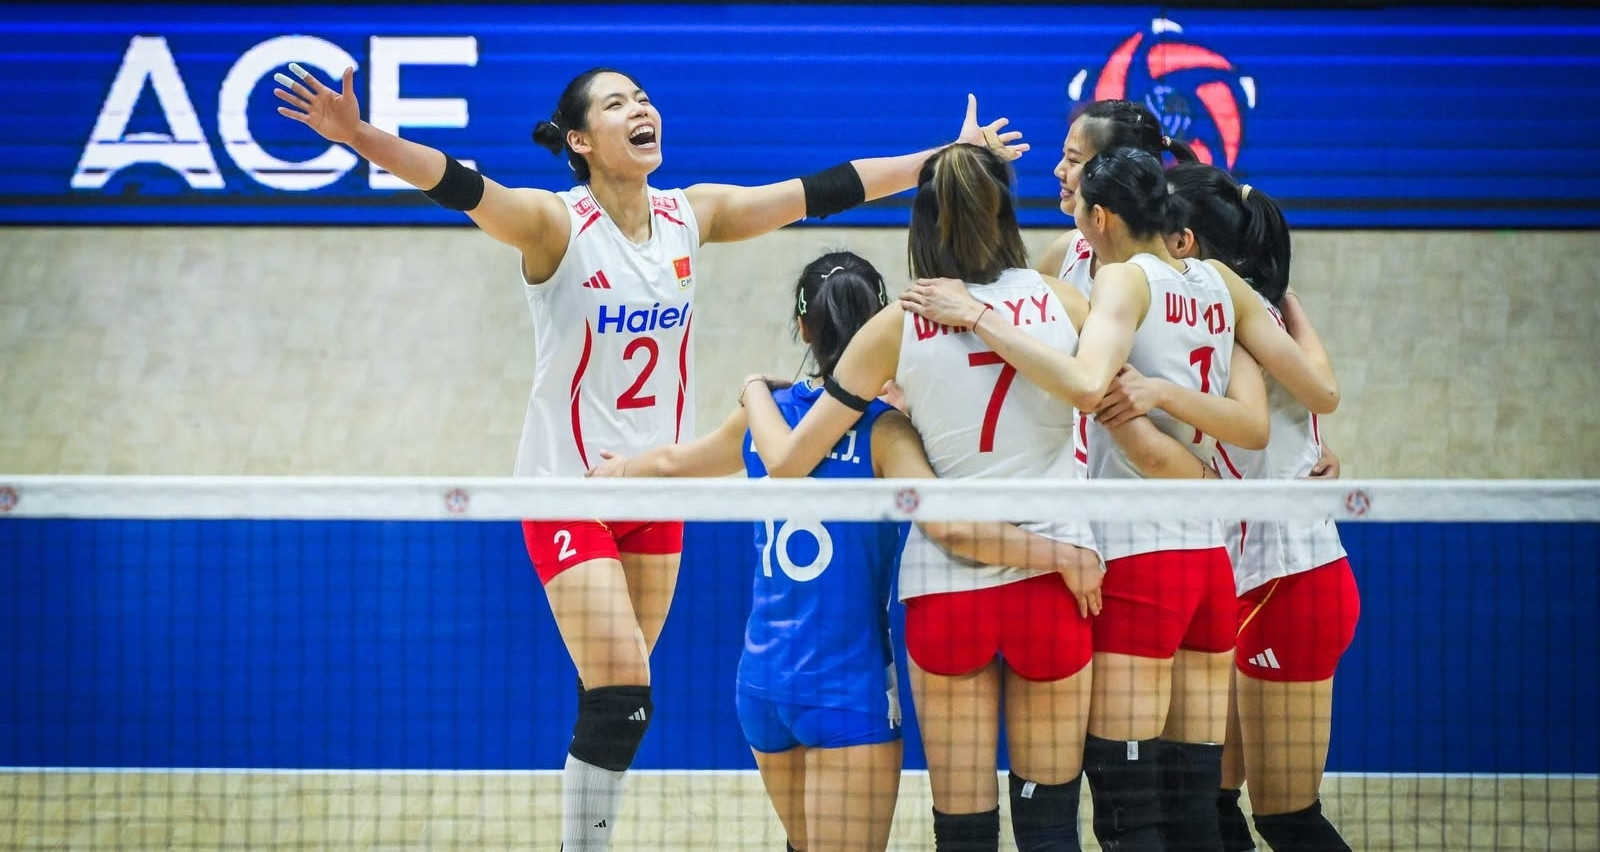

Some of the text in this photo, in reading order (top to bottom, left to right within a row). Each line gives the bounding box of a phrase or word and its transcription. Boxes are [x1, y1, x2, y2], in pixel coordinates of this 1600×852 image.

[70, 34, 478, 191] ACE
[1003, 293, 1056, 326] Y.Y.
[1165, 292, 1198, 328] WU
[616, 336, 659, 410] 2
[967, 351, 1017, 453] 7
[553, 529, 577, 562] 2
